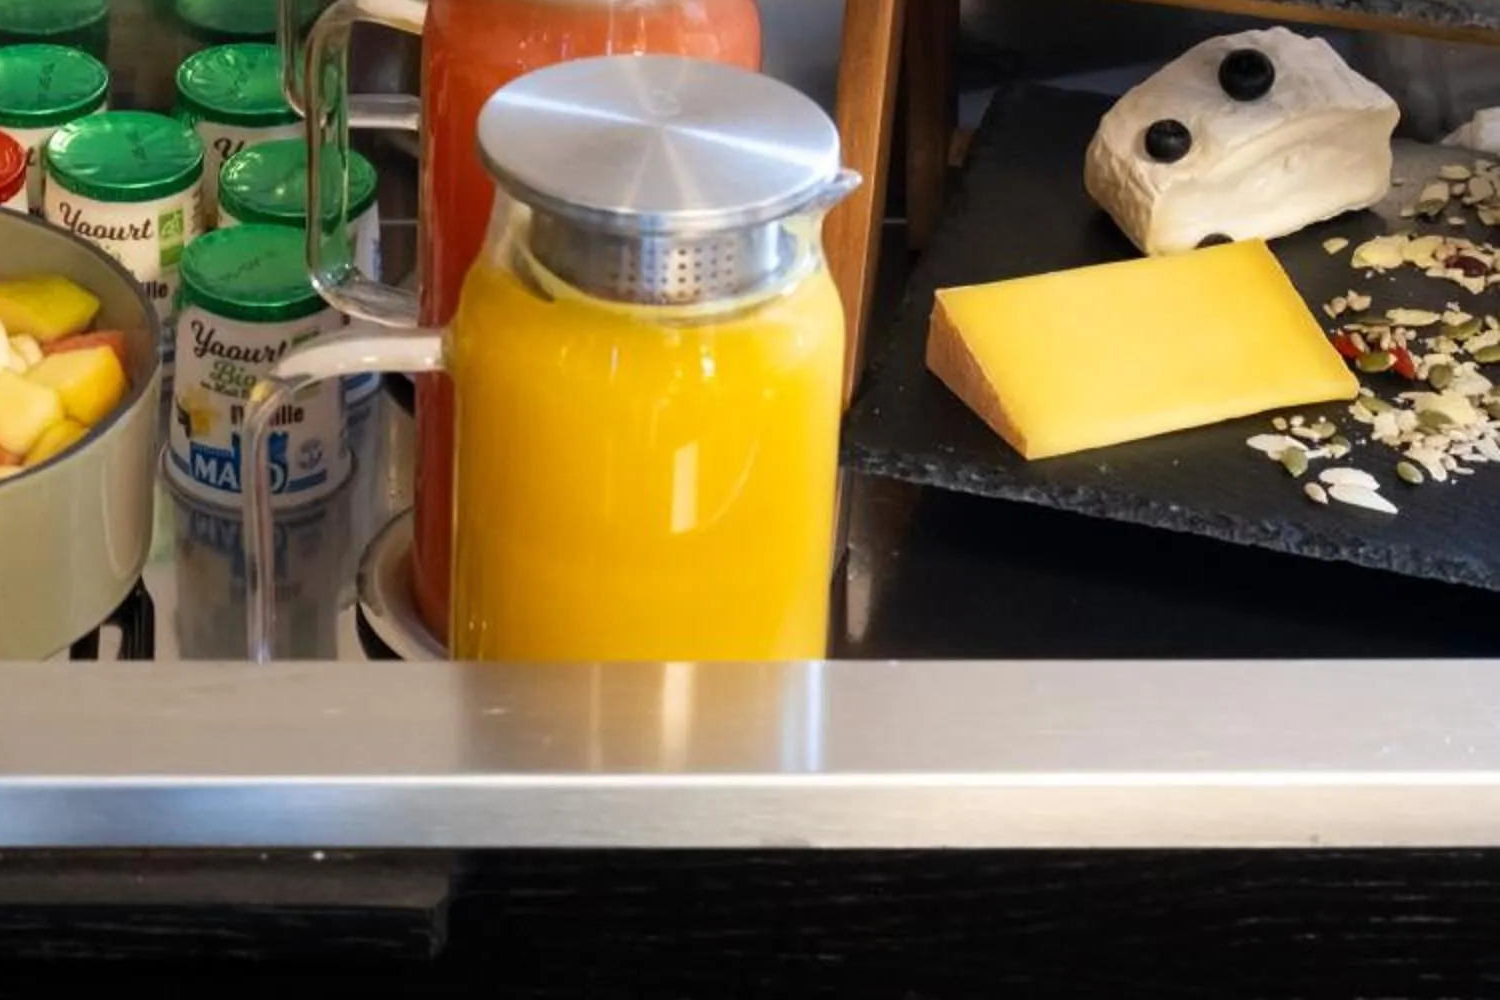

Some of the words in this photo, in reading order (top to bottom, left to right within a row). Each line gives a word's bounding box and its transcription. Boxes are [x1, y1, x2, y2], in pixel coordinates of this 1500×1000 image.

[59, 201, 154, 240] Yaourt
[191, 320, 288, 363] Yaourt
[209, 360, 257, 388] Bio
[194, 453, 286, 491] MAO
